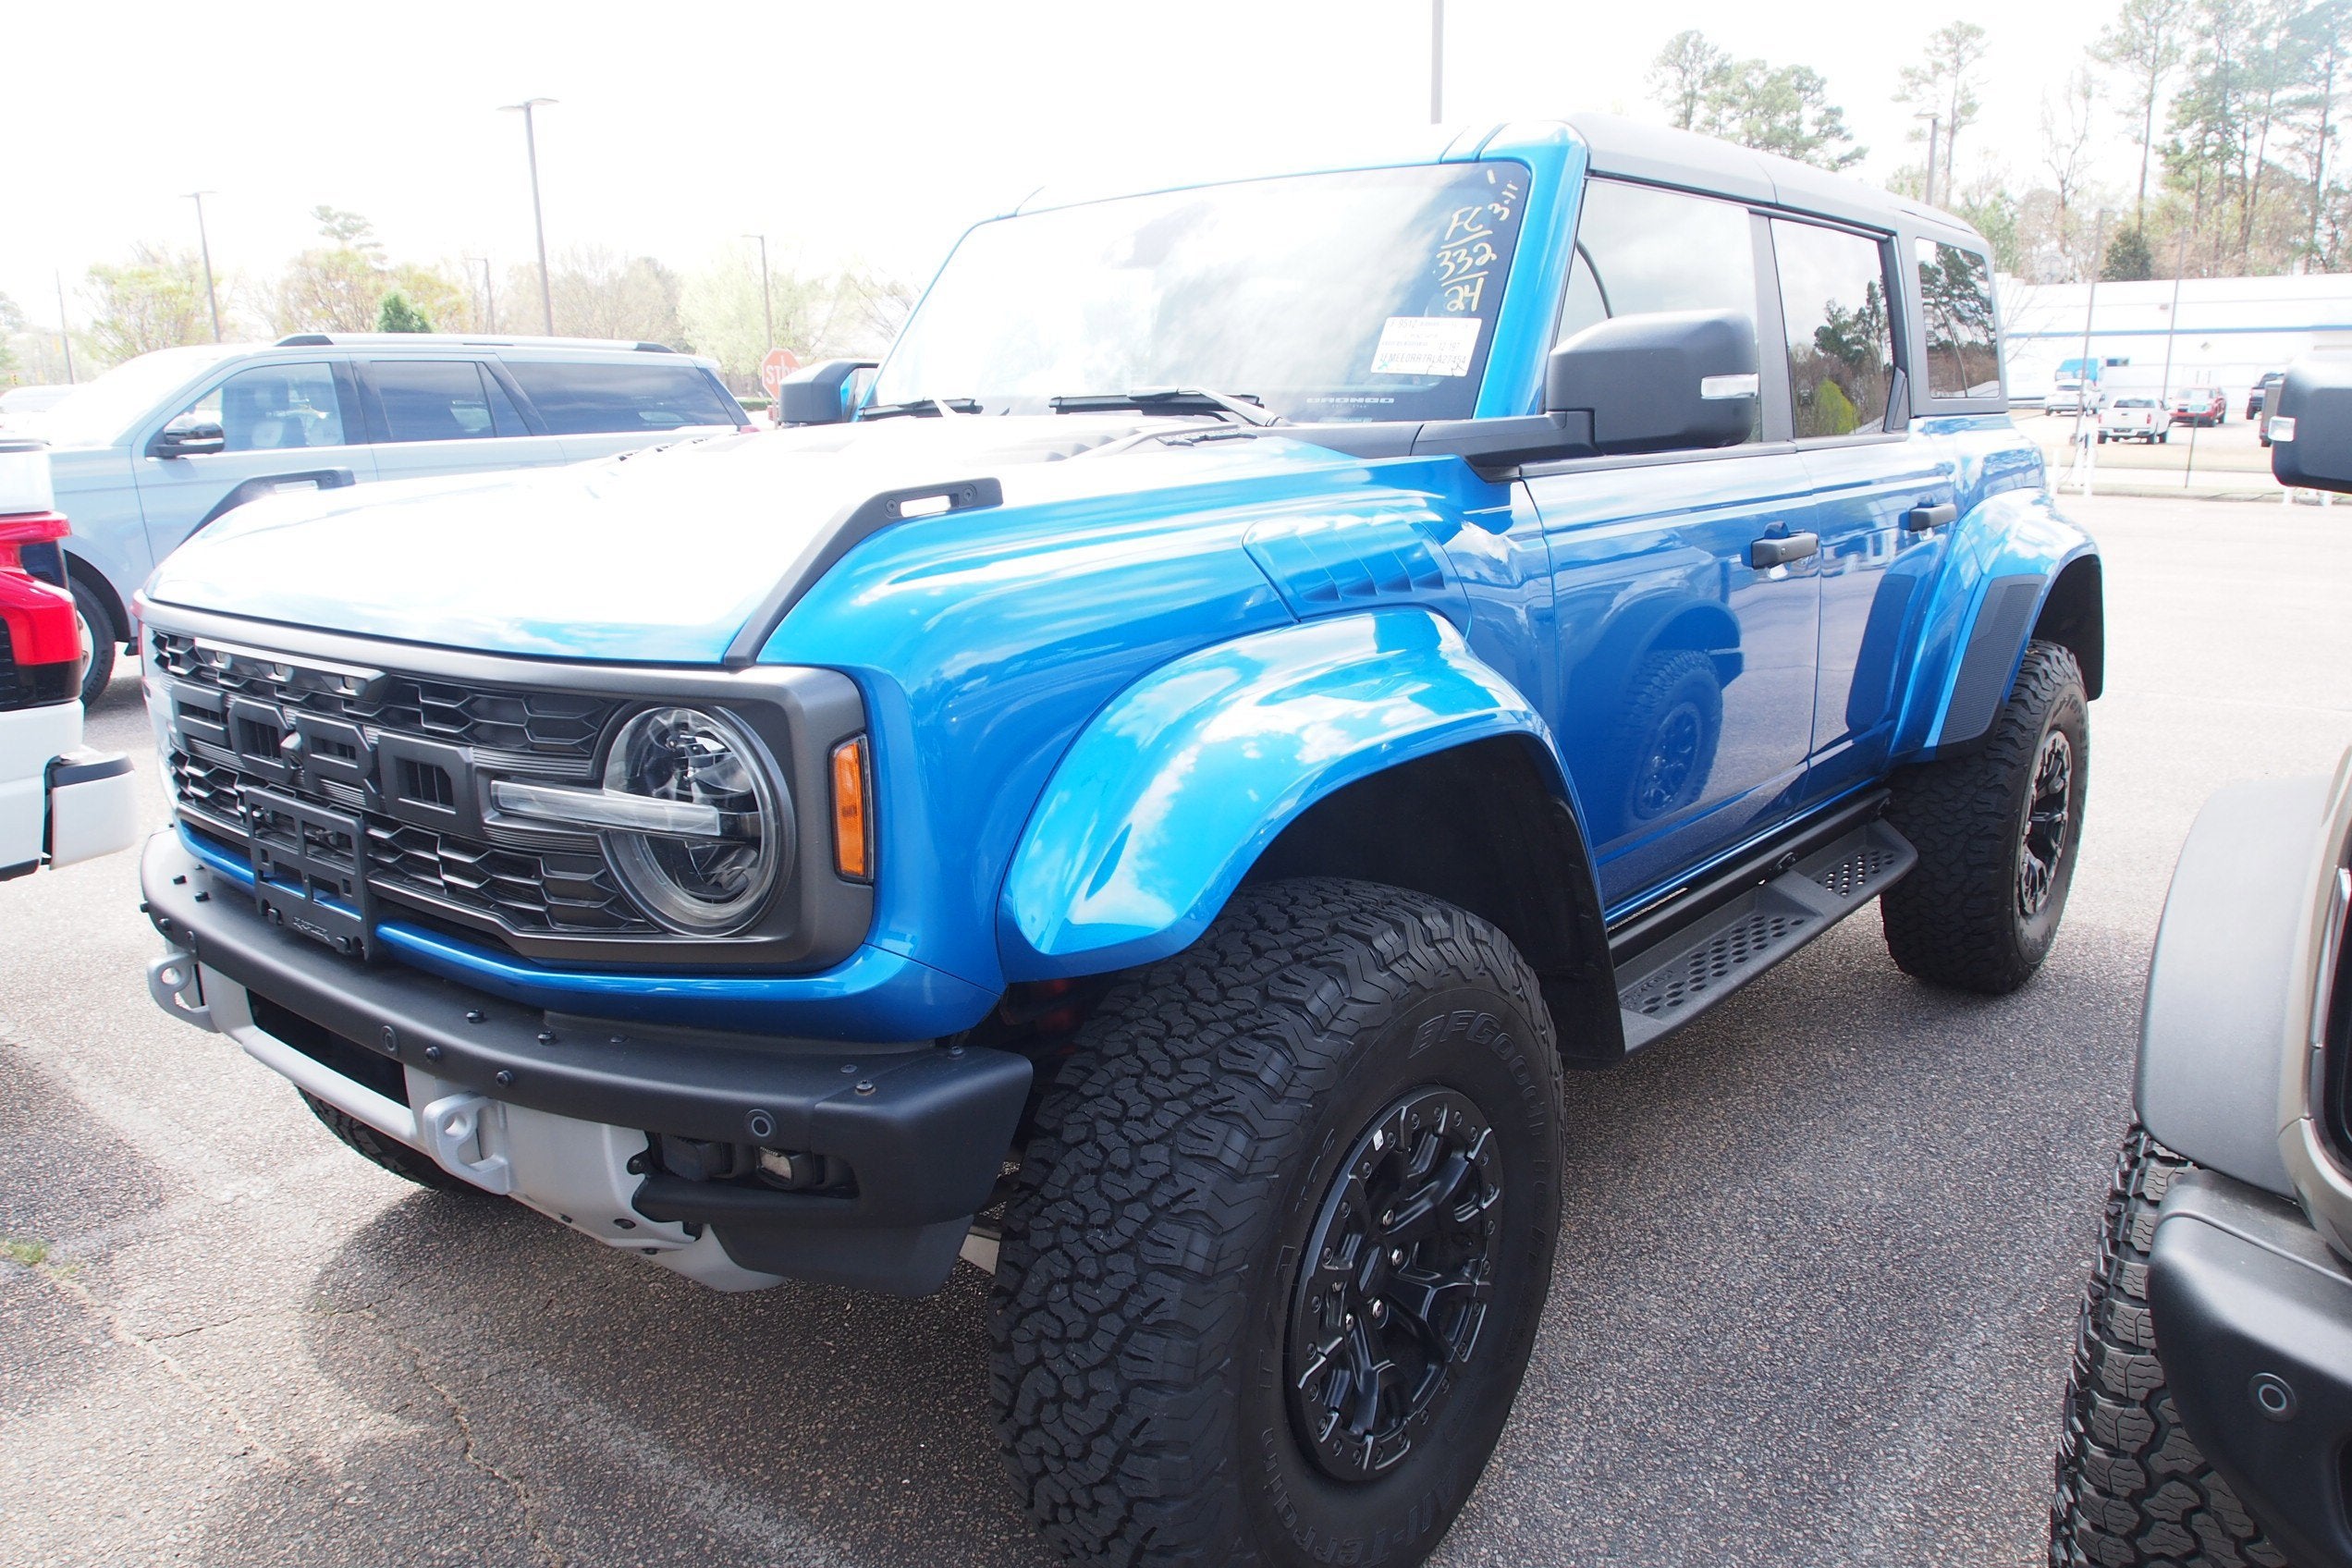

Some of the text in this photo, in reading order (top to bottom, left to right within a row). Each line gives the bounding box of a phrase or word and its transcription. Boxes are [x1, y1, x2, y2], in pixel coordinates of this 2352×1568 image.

[1444, 206, 1484, 241] FC
[1436, 242, 1498, 281] 332
[1444, 277, 1485, 312] 24
[170, 677, 475, 837] FORD
